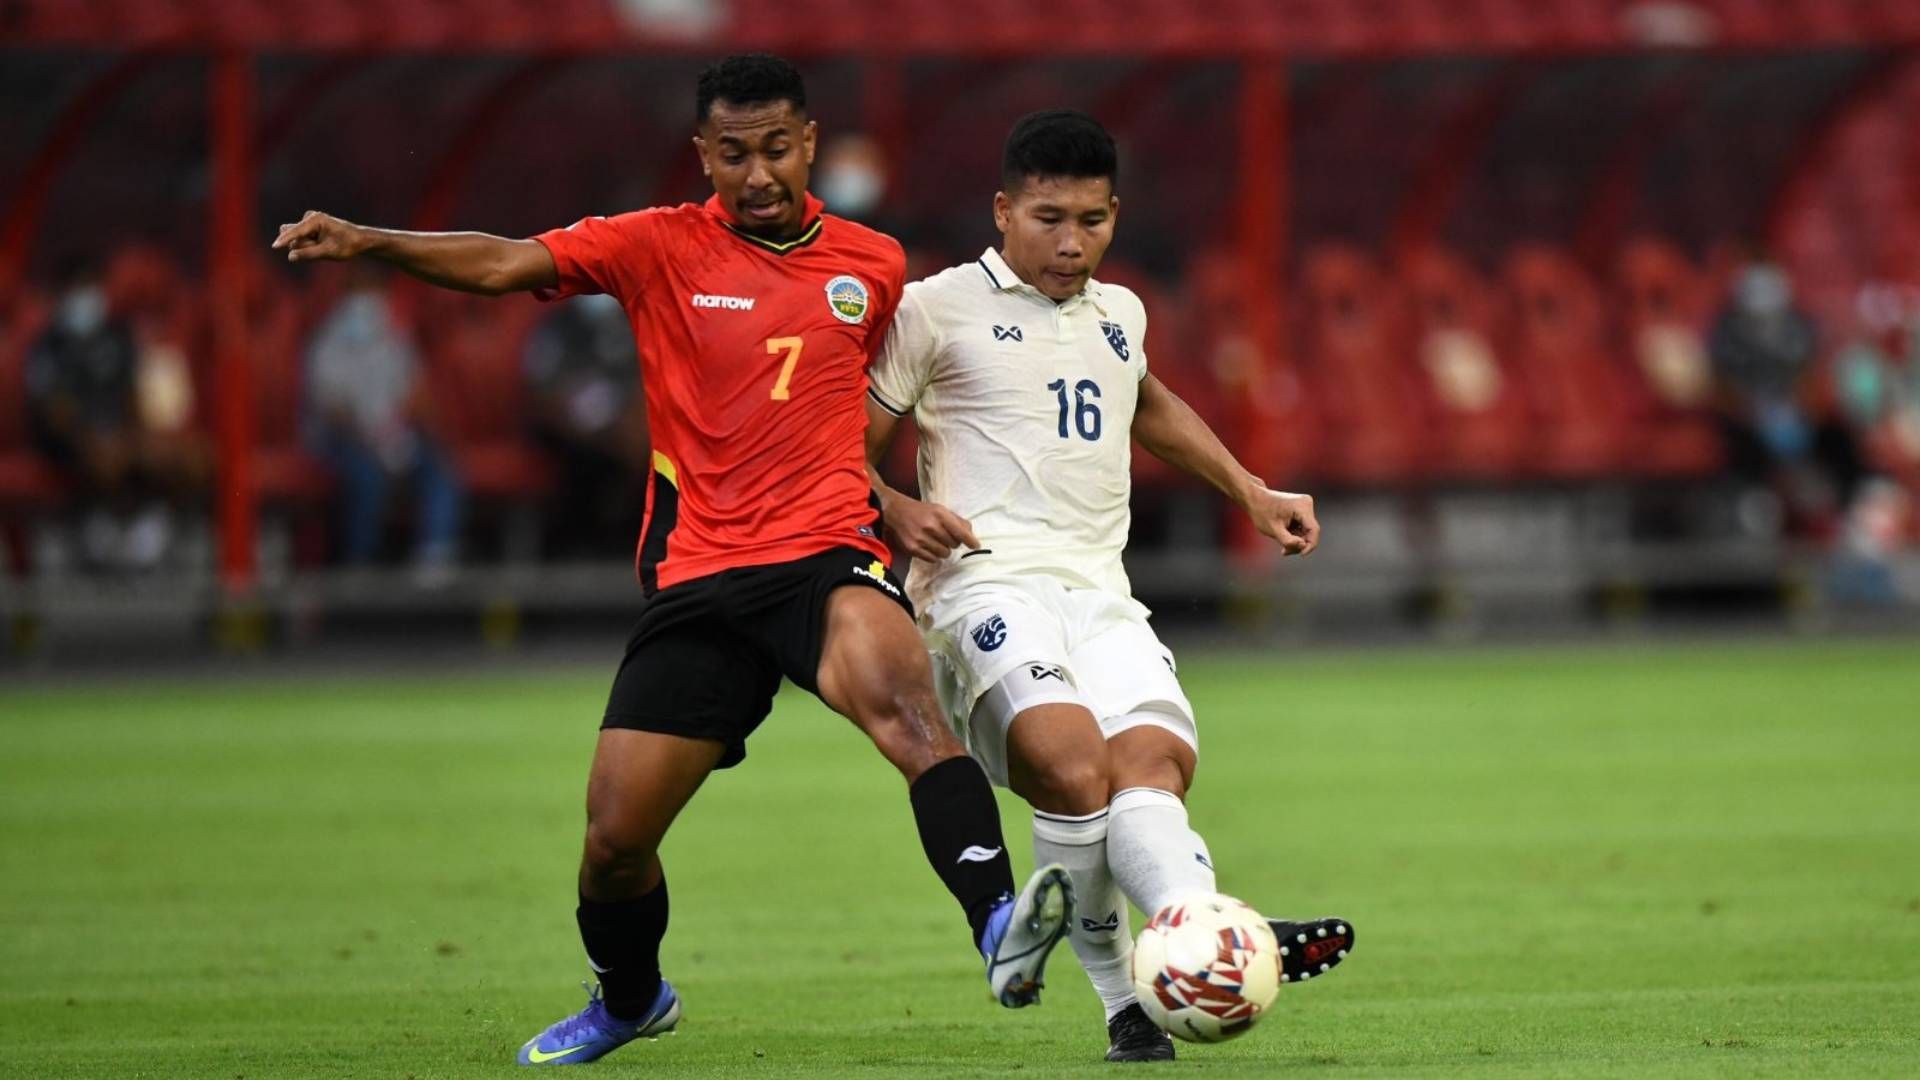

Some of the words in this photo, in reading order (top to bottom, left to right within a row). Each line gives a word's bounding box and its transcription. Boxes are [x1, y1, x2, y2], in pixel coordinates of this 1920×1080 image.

[692, 294, 755, 310] narrow
[766, 336, 804, 401] 7
[1047, 378, 1102, 442] 16
